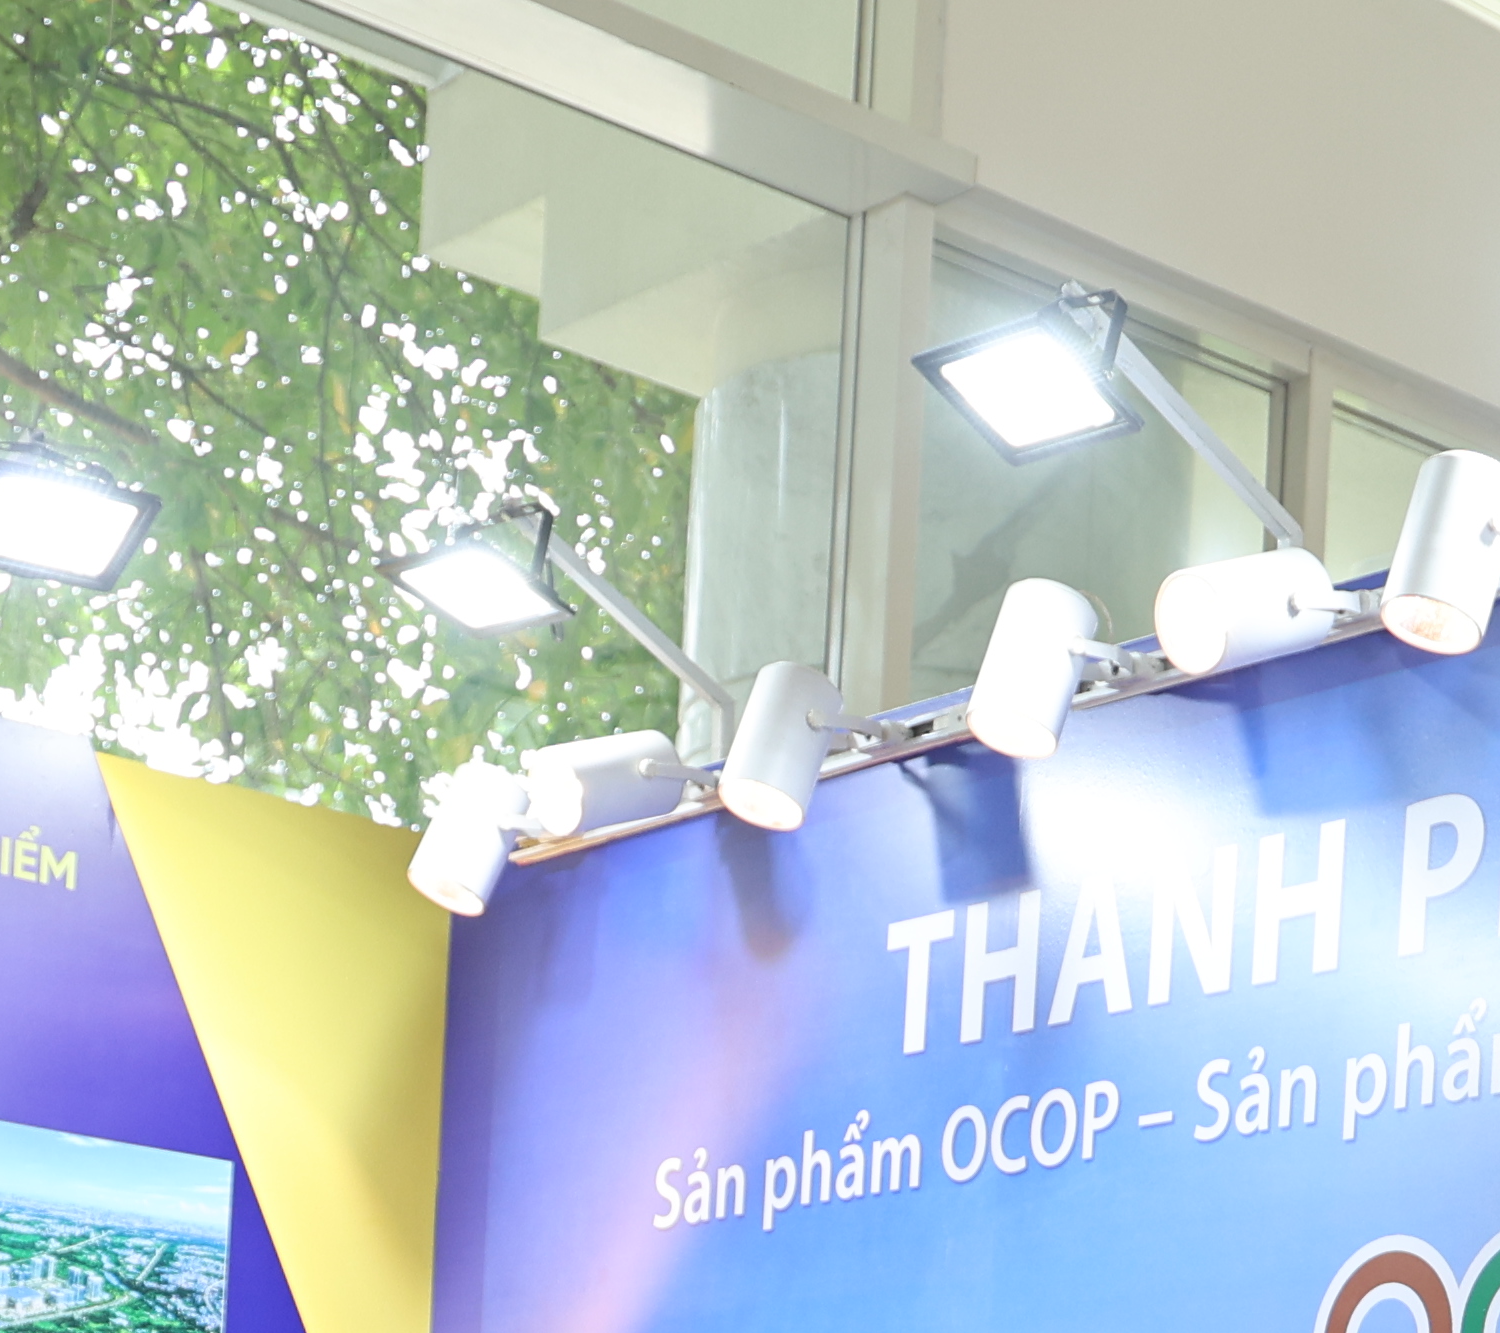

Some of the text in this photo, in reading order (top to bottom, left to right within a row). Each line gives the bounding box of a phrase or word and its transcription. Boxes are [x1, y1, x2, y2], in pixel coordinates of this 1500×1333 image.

[652, 1147, 747, 1231] Sản
[762, 1110, 922, 1233] phẩm
[941, 1079, 1120, 1184] OCOP
[1194, 1046, 1318, 1143] Sản
